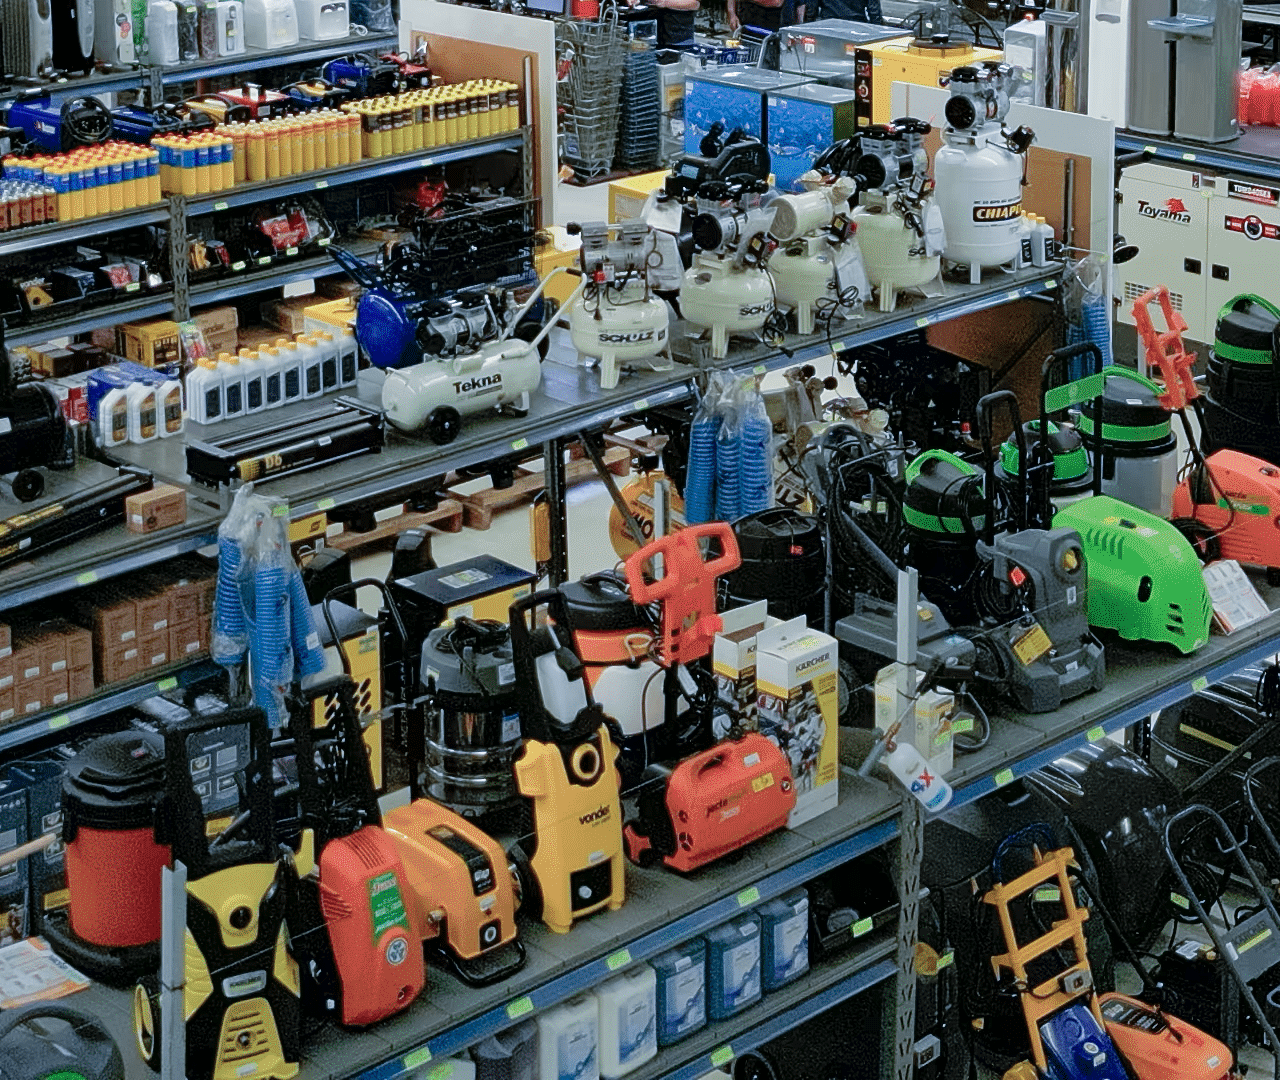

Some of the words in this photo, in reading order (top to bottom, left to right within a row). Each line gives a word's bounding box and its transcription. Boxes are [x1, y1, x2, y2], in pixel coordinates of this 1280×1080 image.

[1137, 200, 1192, 225] Toyama
[599, 330, 654, 344] SCHULZ
[452, 372, 503, 396] Tekna
[578, 805, 611, 826] vonder
